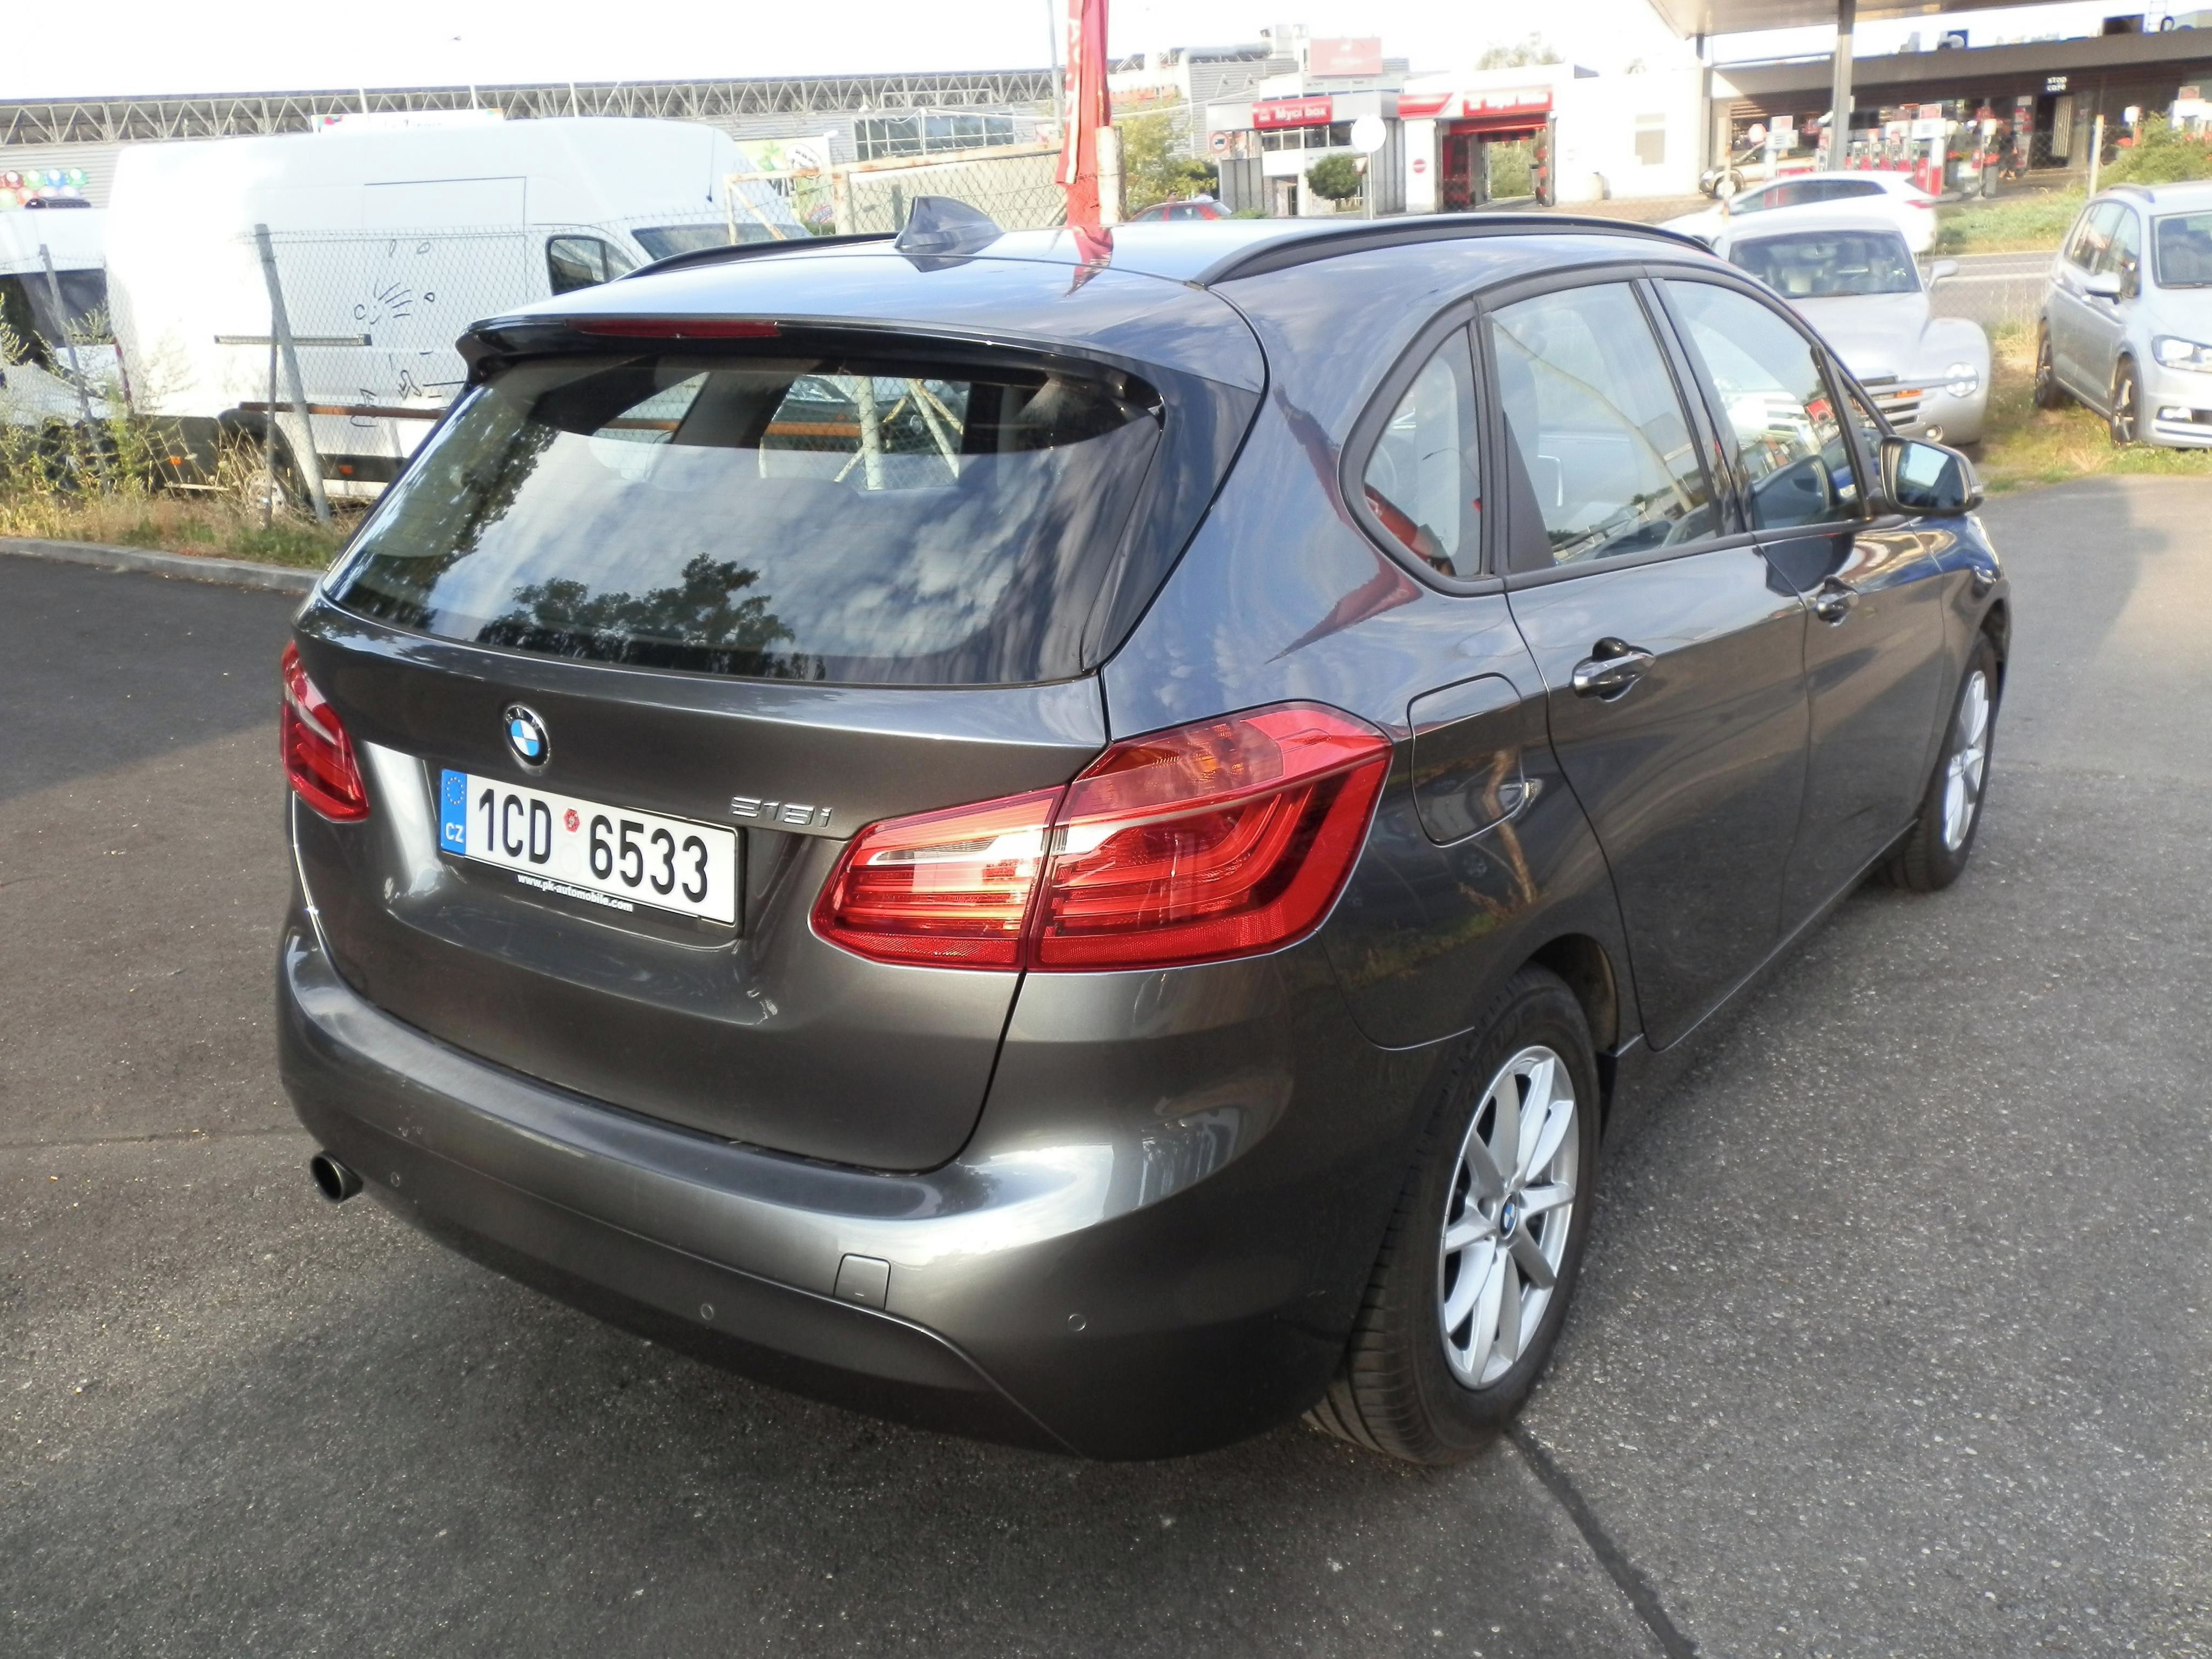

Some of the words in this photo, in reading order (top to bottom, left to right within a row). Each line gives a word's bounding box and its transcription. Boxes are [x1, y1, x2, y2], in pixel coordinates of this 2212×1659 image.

[1304, 105, 1327, 118] box
[446, 822, 463, 843] CZ
[479, 788, 552, 864] 1CD
[590, 814, 708, 903] 6533
[517, 874, 633, 913] www.pk-automobile.com
